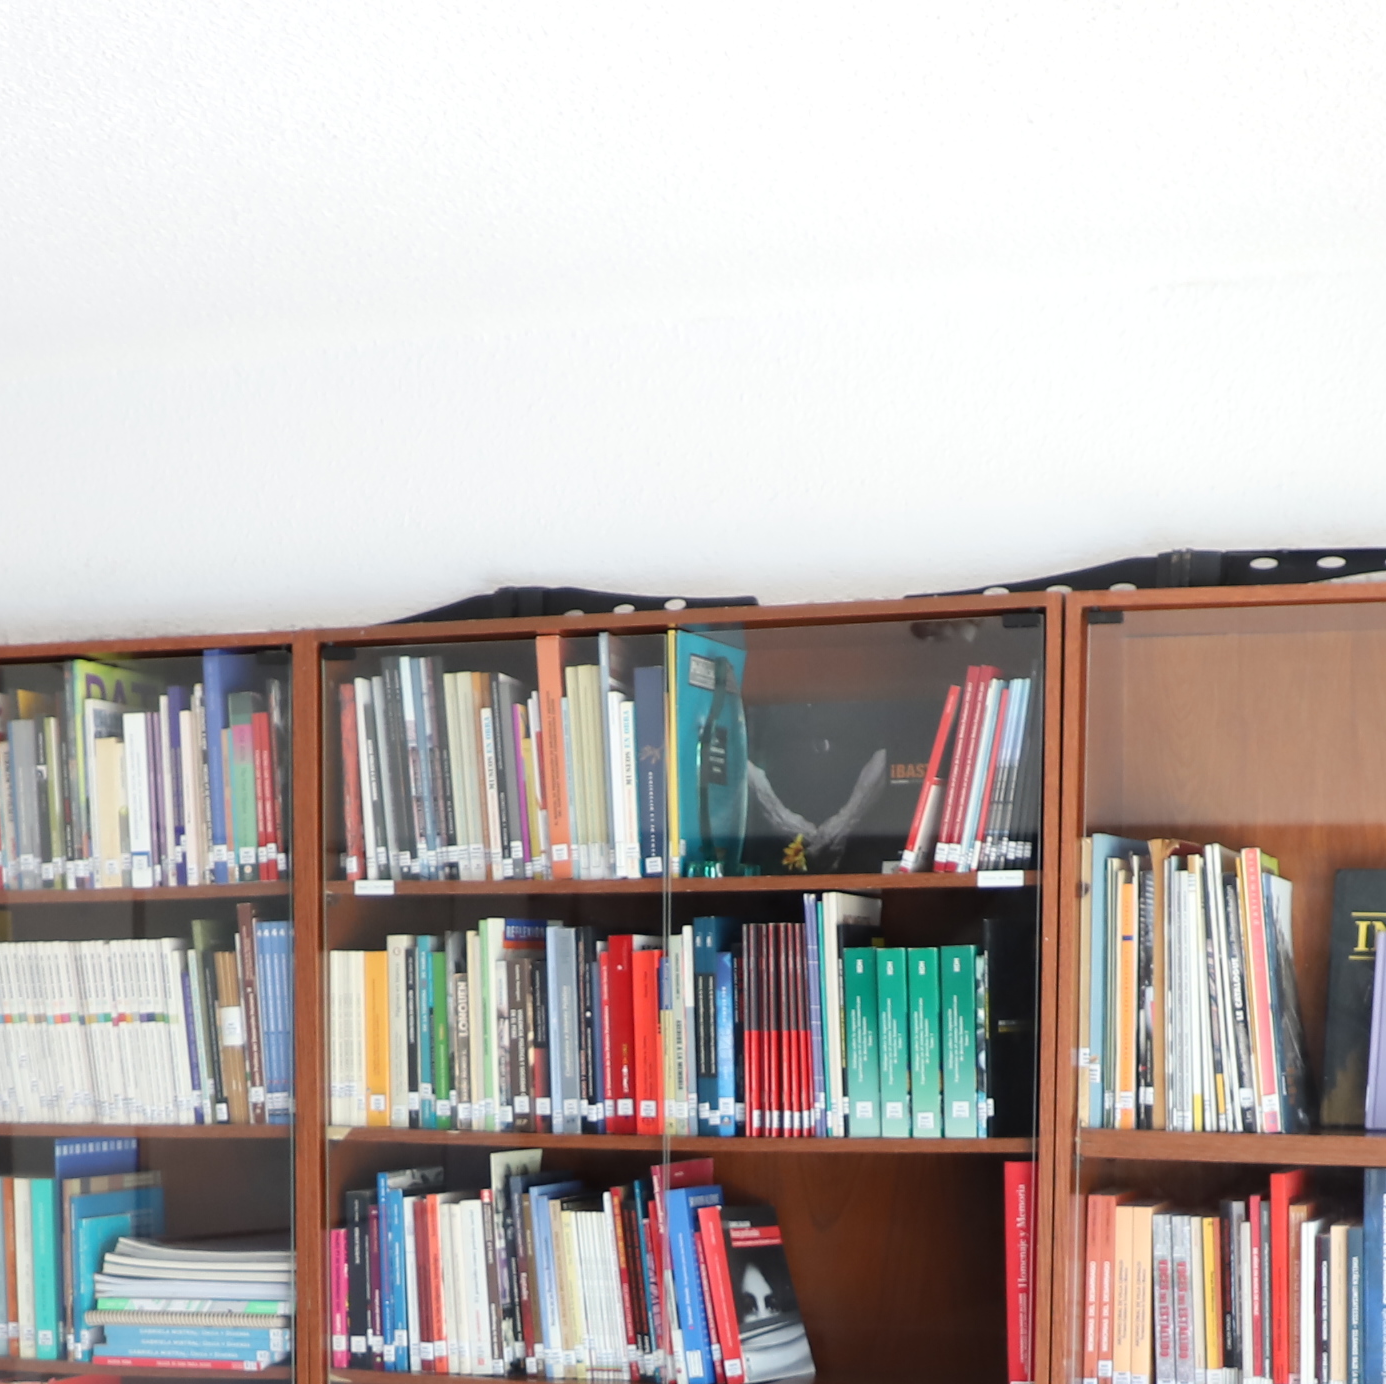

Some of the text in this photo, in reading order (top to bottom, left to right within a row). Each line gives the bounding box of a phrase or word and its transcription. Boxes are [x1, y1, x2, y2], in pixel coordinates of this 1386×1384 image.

[486, 742, 492, 753] EN
[624, 737, 630, 748] EN
[487, 757, 495, 789] MUSEOS
[1230, 957, 1243, 1007] CATALOGUE
[458, 981, 468, 1037] LONQUEN
[1235, 1009, 1244, 1021] LE
[1016, 1184, 1026, 1228] Memoria
[1018, 1238, 1027, 1288] Homenaje
[1158, 1260, 1168, 1290] VOCES
[1177, 1262, 1187, 1292] VOCES
[1160, 1305, 1170, 1357] ESTALLIDO
[1179, 1308, 1190, 1359] ESTALLIDO
